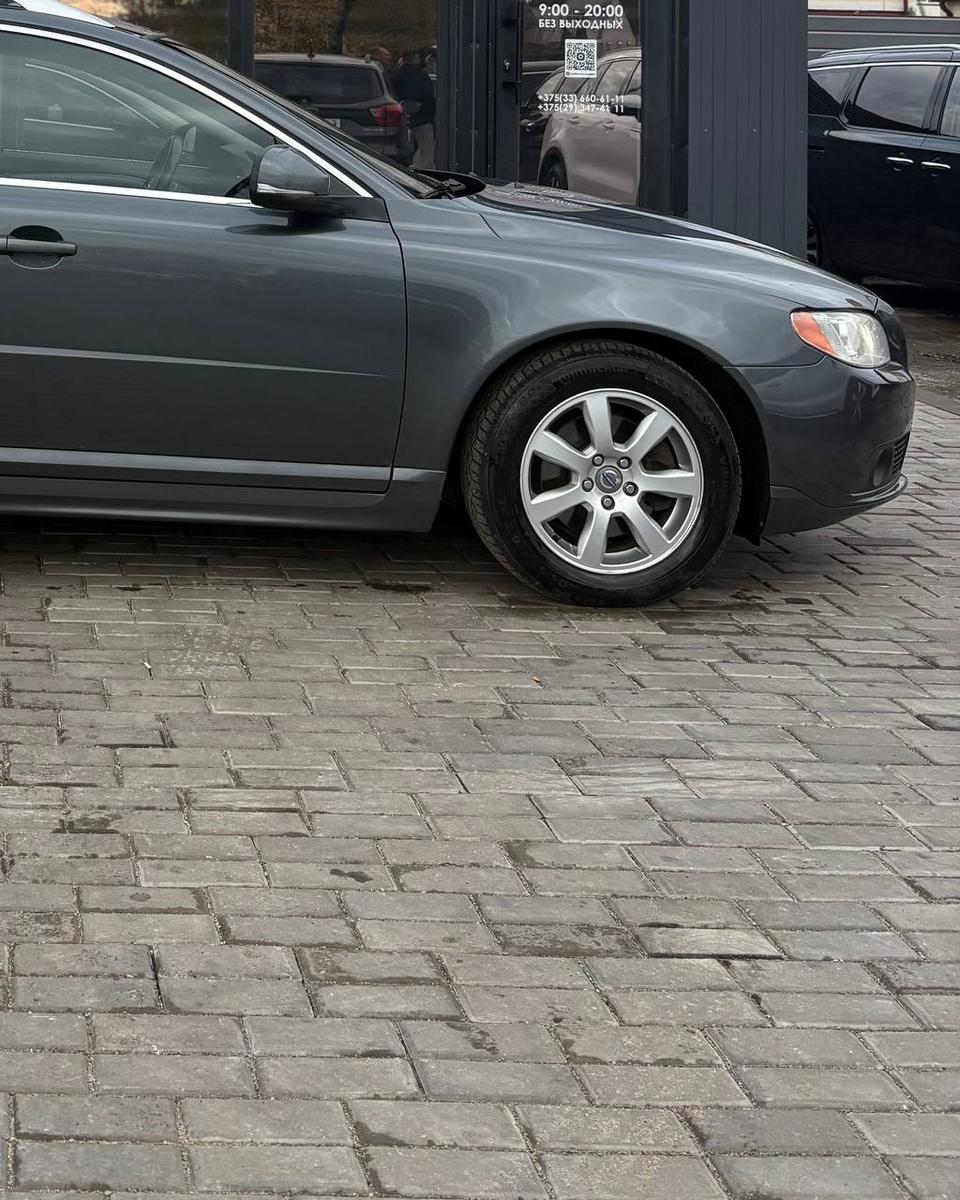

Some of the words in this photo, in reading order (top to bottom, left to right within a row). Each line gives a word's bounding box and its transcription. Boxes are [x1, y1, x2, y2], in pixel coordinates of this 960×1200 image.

[539, 4, 569, 17] 9:00
[584, 5, 624, 17] 20:00
[538, 19, 556, 28] БЕЗ
[559, 20, 623, 30] ВЫХОДНЫХ
[538, 94, 577, 104] +375(33)
[580, 95, 624, 103] 660-61-11
[538, 104, 577, 113] +375(29)
